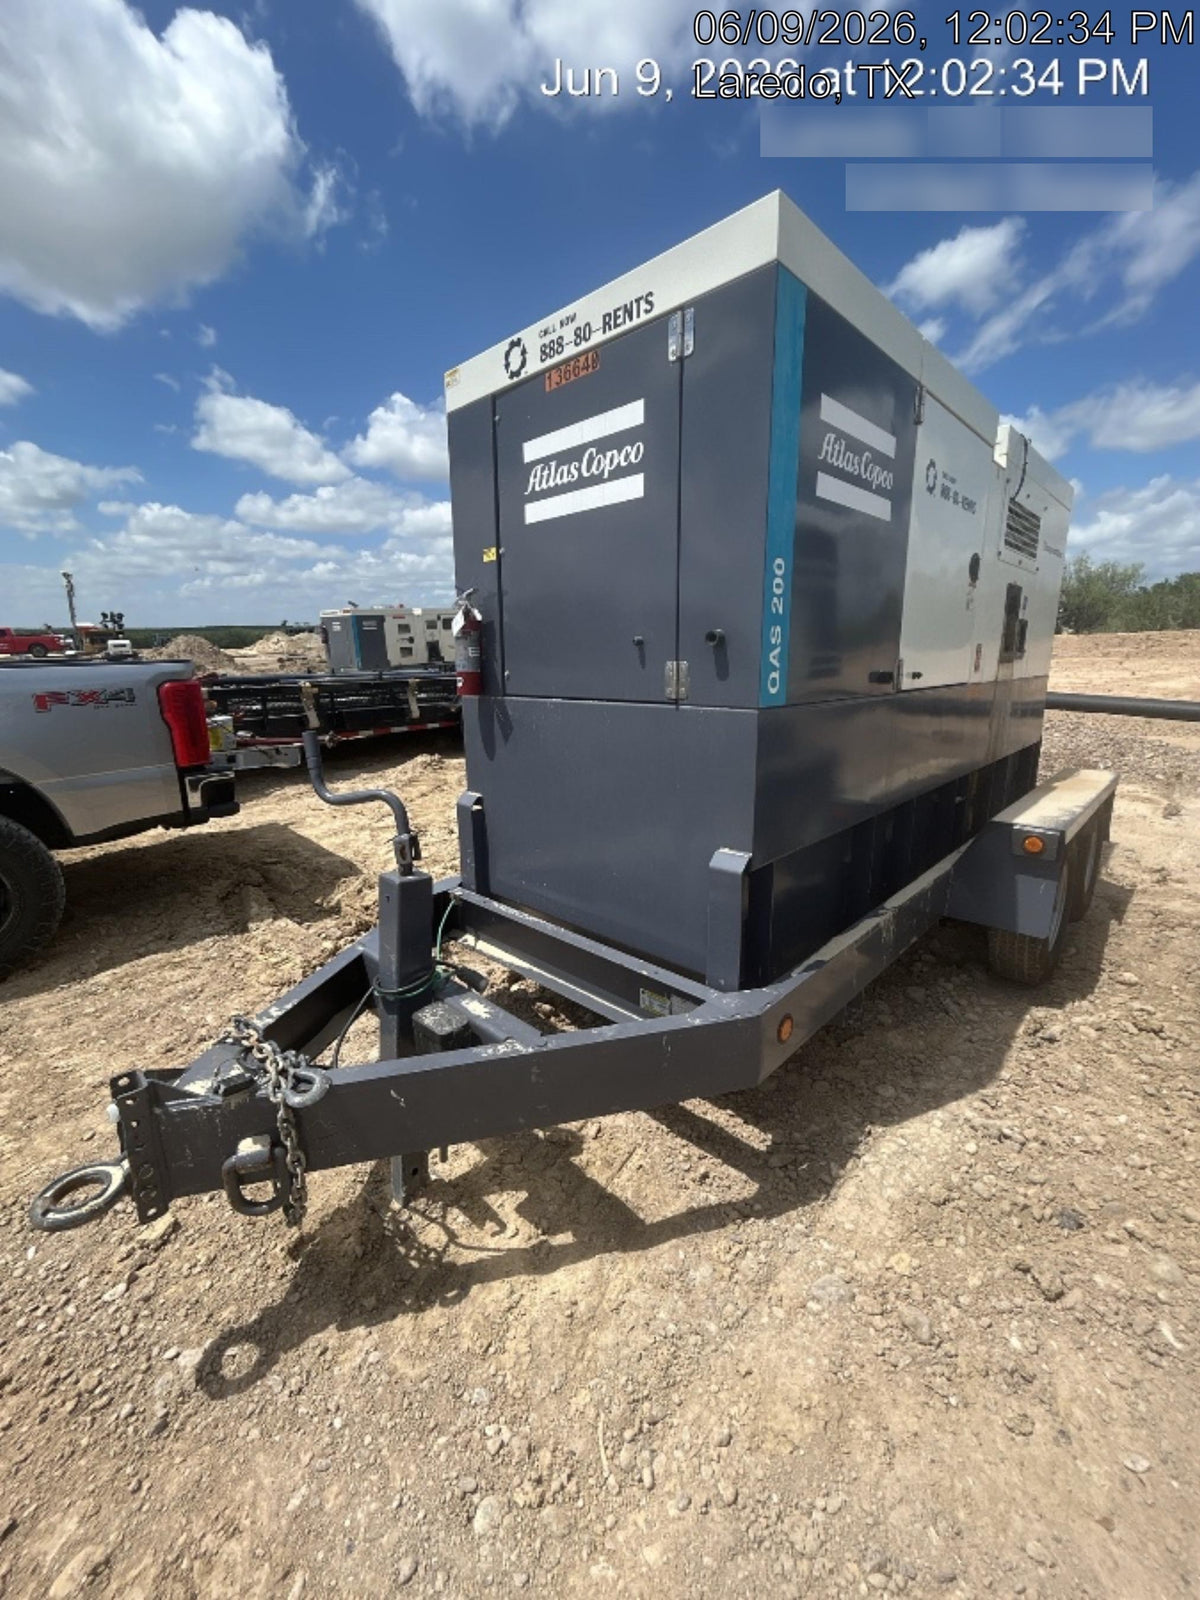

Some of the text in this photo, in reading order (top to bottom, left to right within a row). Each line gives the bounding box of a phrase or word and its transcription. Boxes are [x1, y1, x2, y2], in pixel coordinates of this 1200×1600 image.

[524, 441, 645, 495] Atlas Copco
[767, 557, 785, 694] QAS 200
